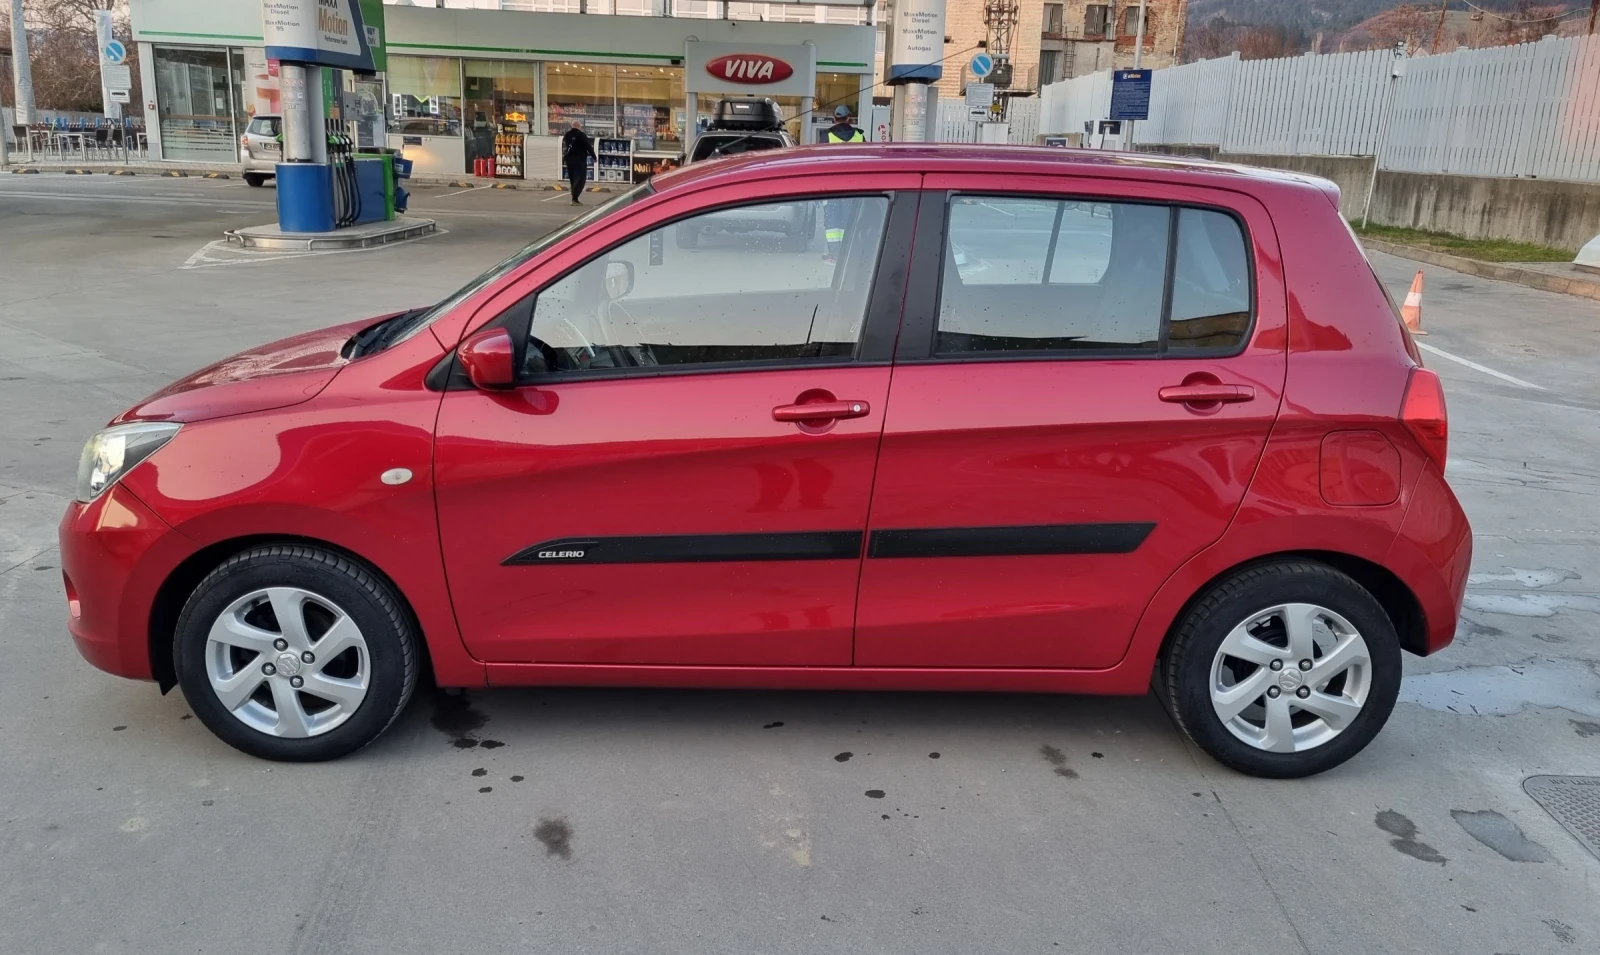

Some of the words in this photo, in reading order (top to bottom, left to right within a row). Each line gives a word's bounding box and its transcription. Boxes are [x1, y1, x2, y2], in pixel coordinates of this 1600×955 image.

[318, 7, 348, 36] Motion
[725, 59, 774, 79] VIVA
[538, 550, 585, 559] CELERIO
